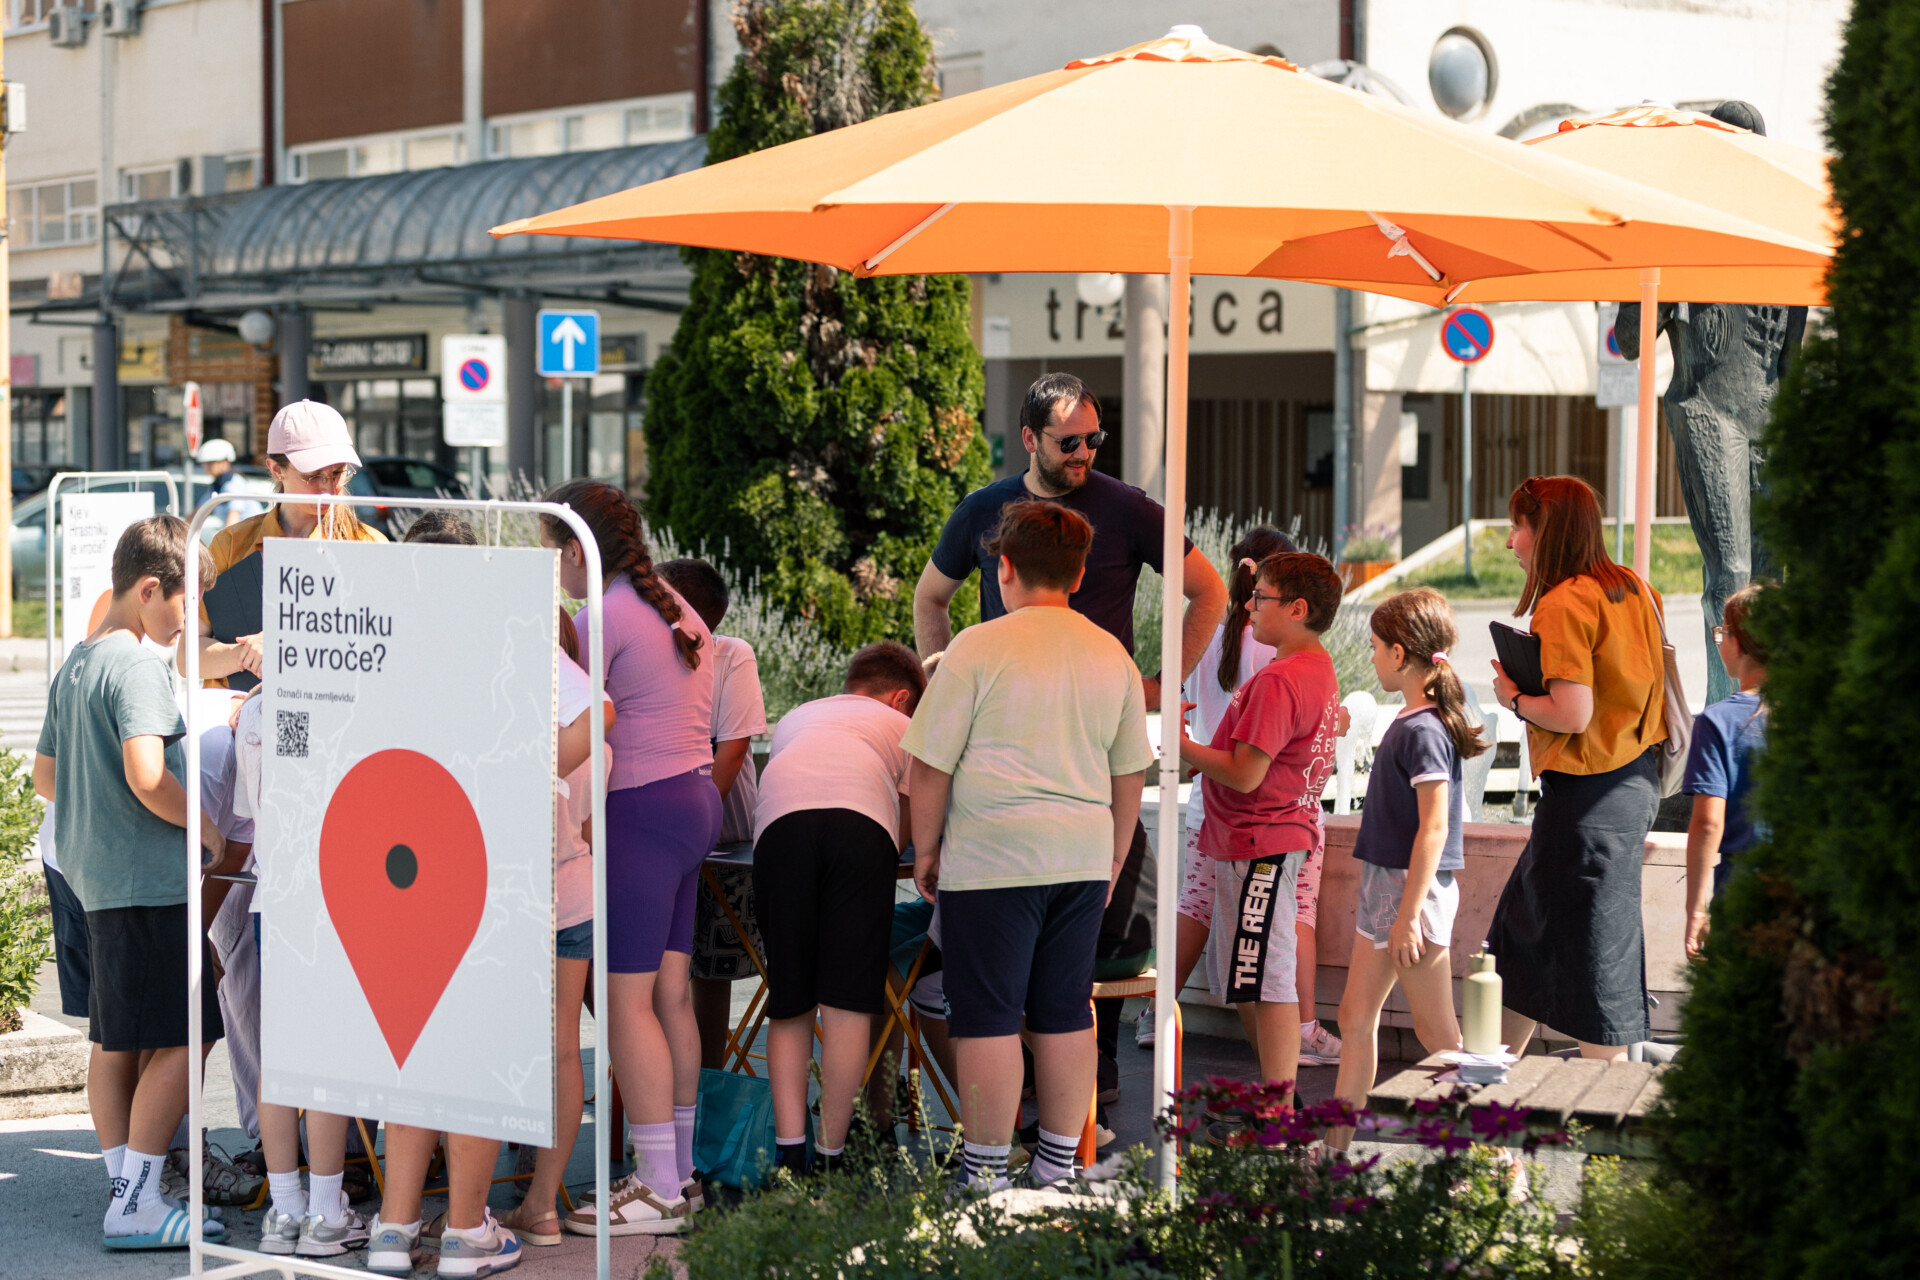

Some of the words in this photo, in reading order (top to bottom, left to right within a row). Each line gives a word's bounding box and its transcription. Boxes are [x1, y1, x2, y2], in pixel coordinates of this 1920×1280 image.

[279, 566, 315, 604] Kje
[321, 575, 336, 598] v
[279, 602, 392, 638] Hrastniku
[278, 638, 298, 675] je
[305, 641, 387, 673] vroče?
[276, 687, 302, 700] Označi
[303, 690, 313, 700] na
[1241, 863, 1279, 934] REAL
[1234, 937, 1260, 990] THE
